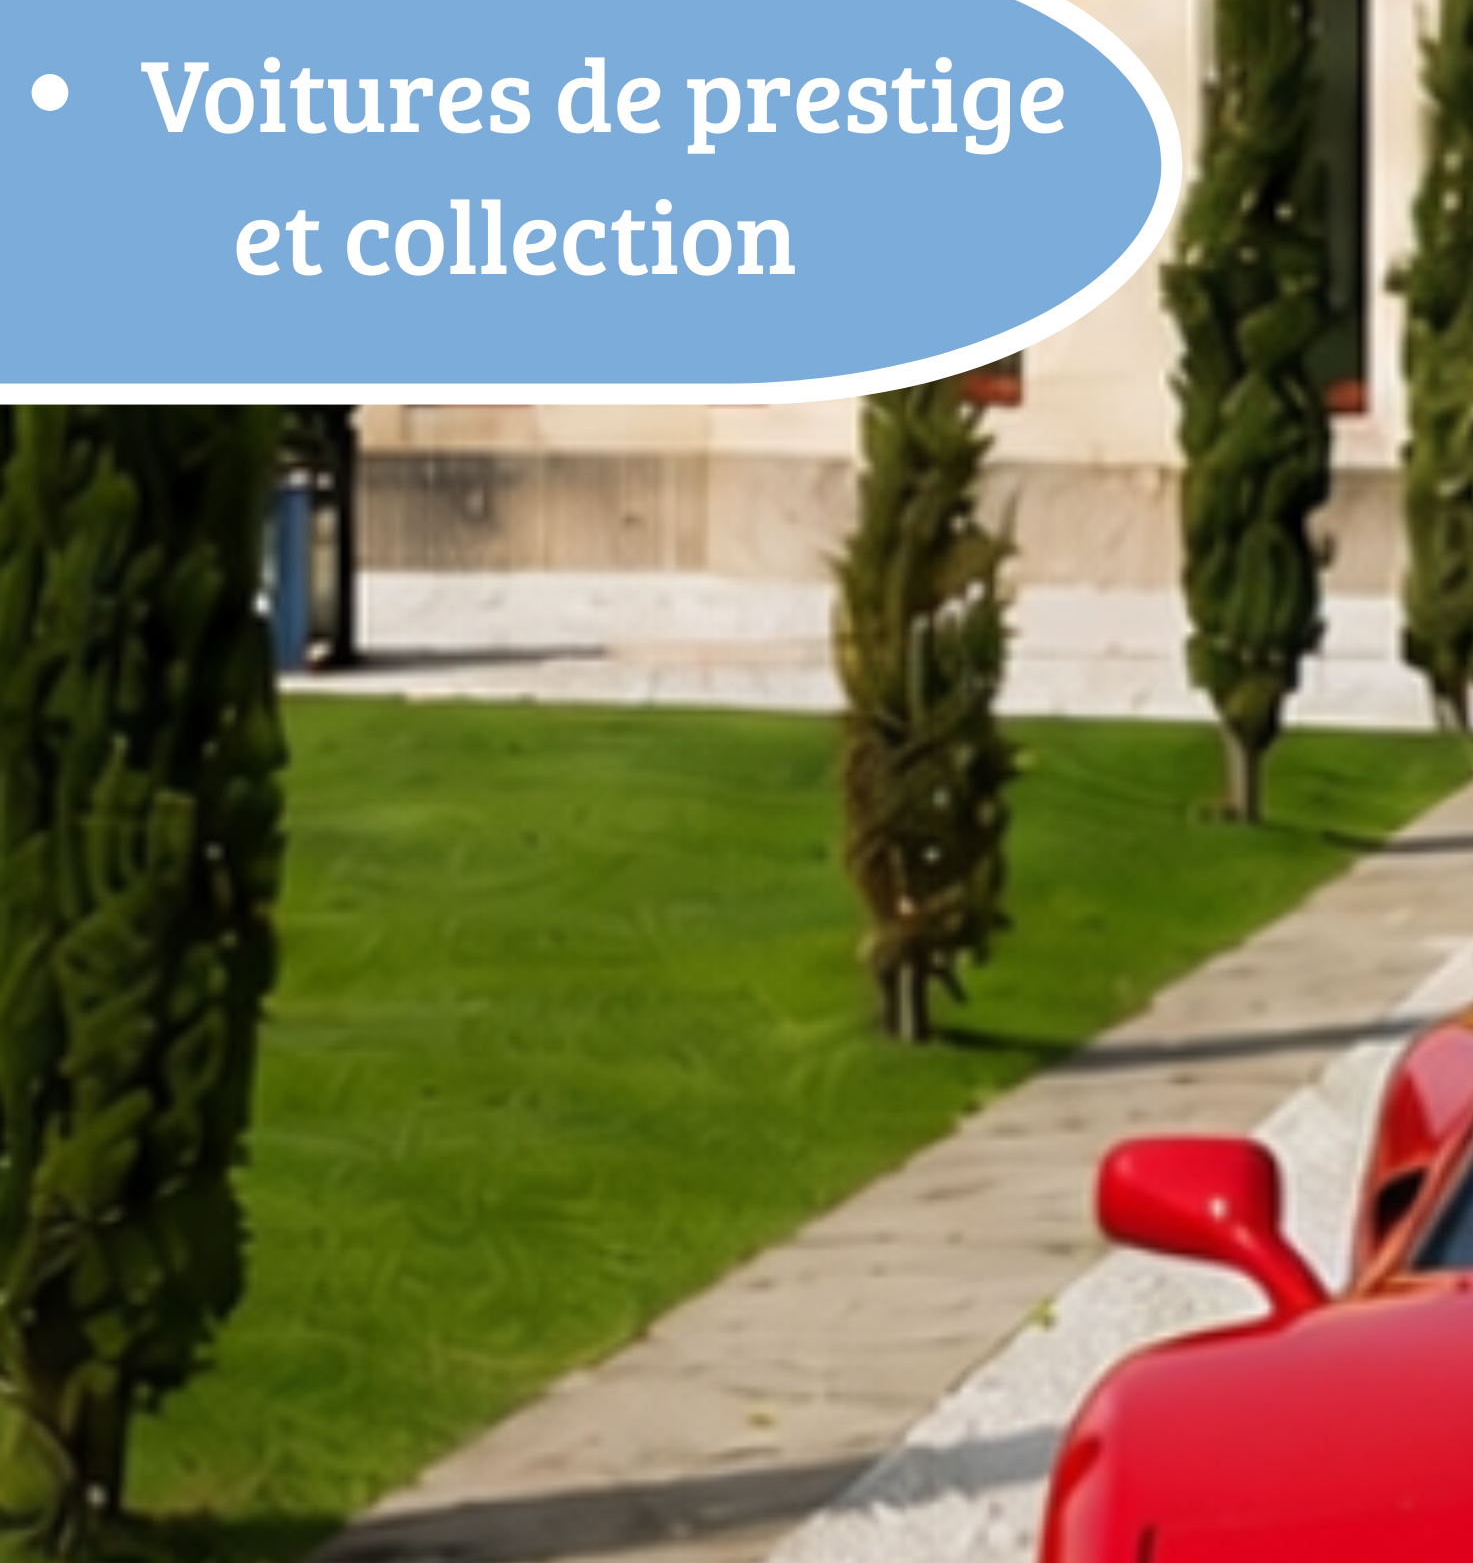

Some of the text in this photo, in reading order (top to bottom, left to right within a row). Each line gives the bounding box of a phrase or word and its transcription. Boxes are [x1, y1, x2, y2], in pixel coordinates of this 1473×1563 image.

[140, 56, 1064, 155] Voitures de prestige
[236, 198, 796, 276] et collection
